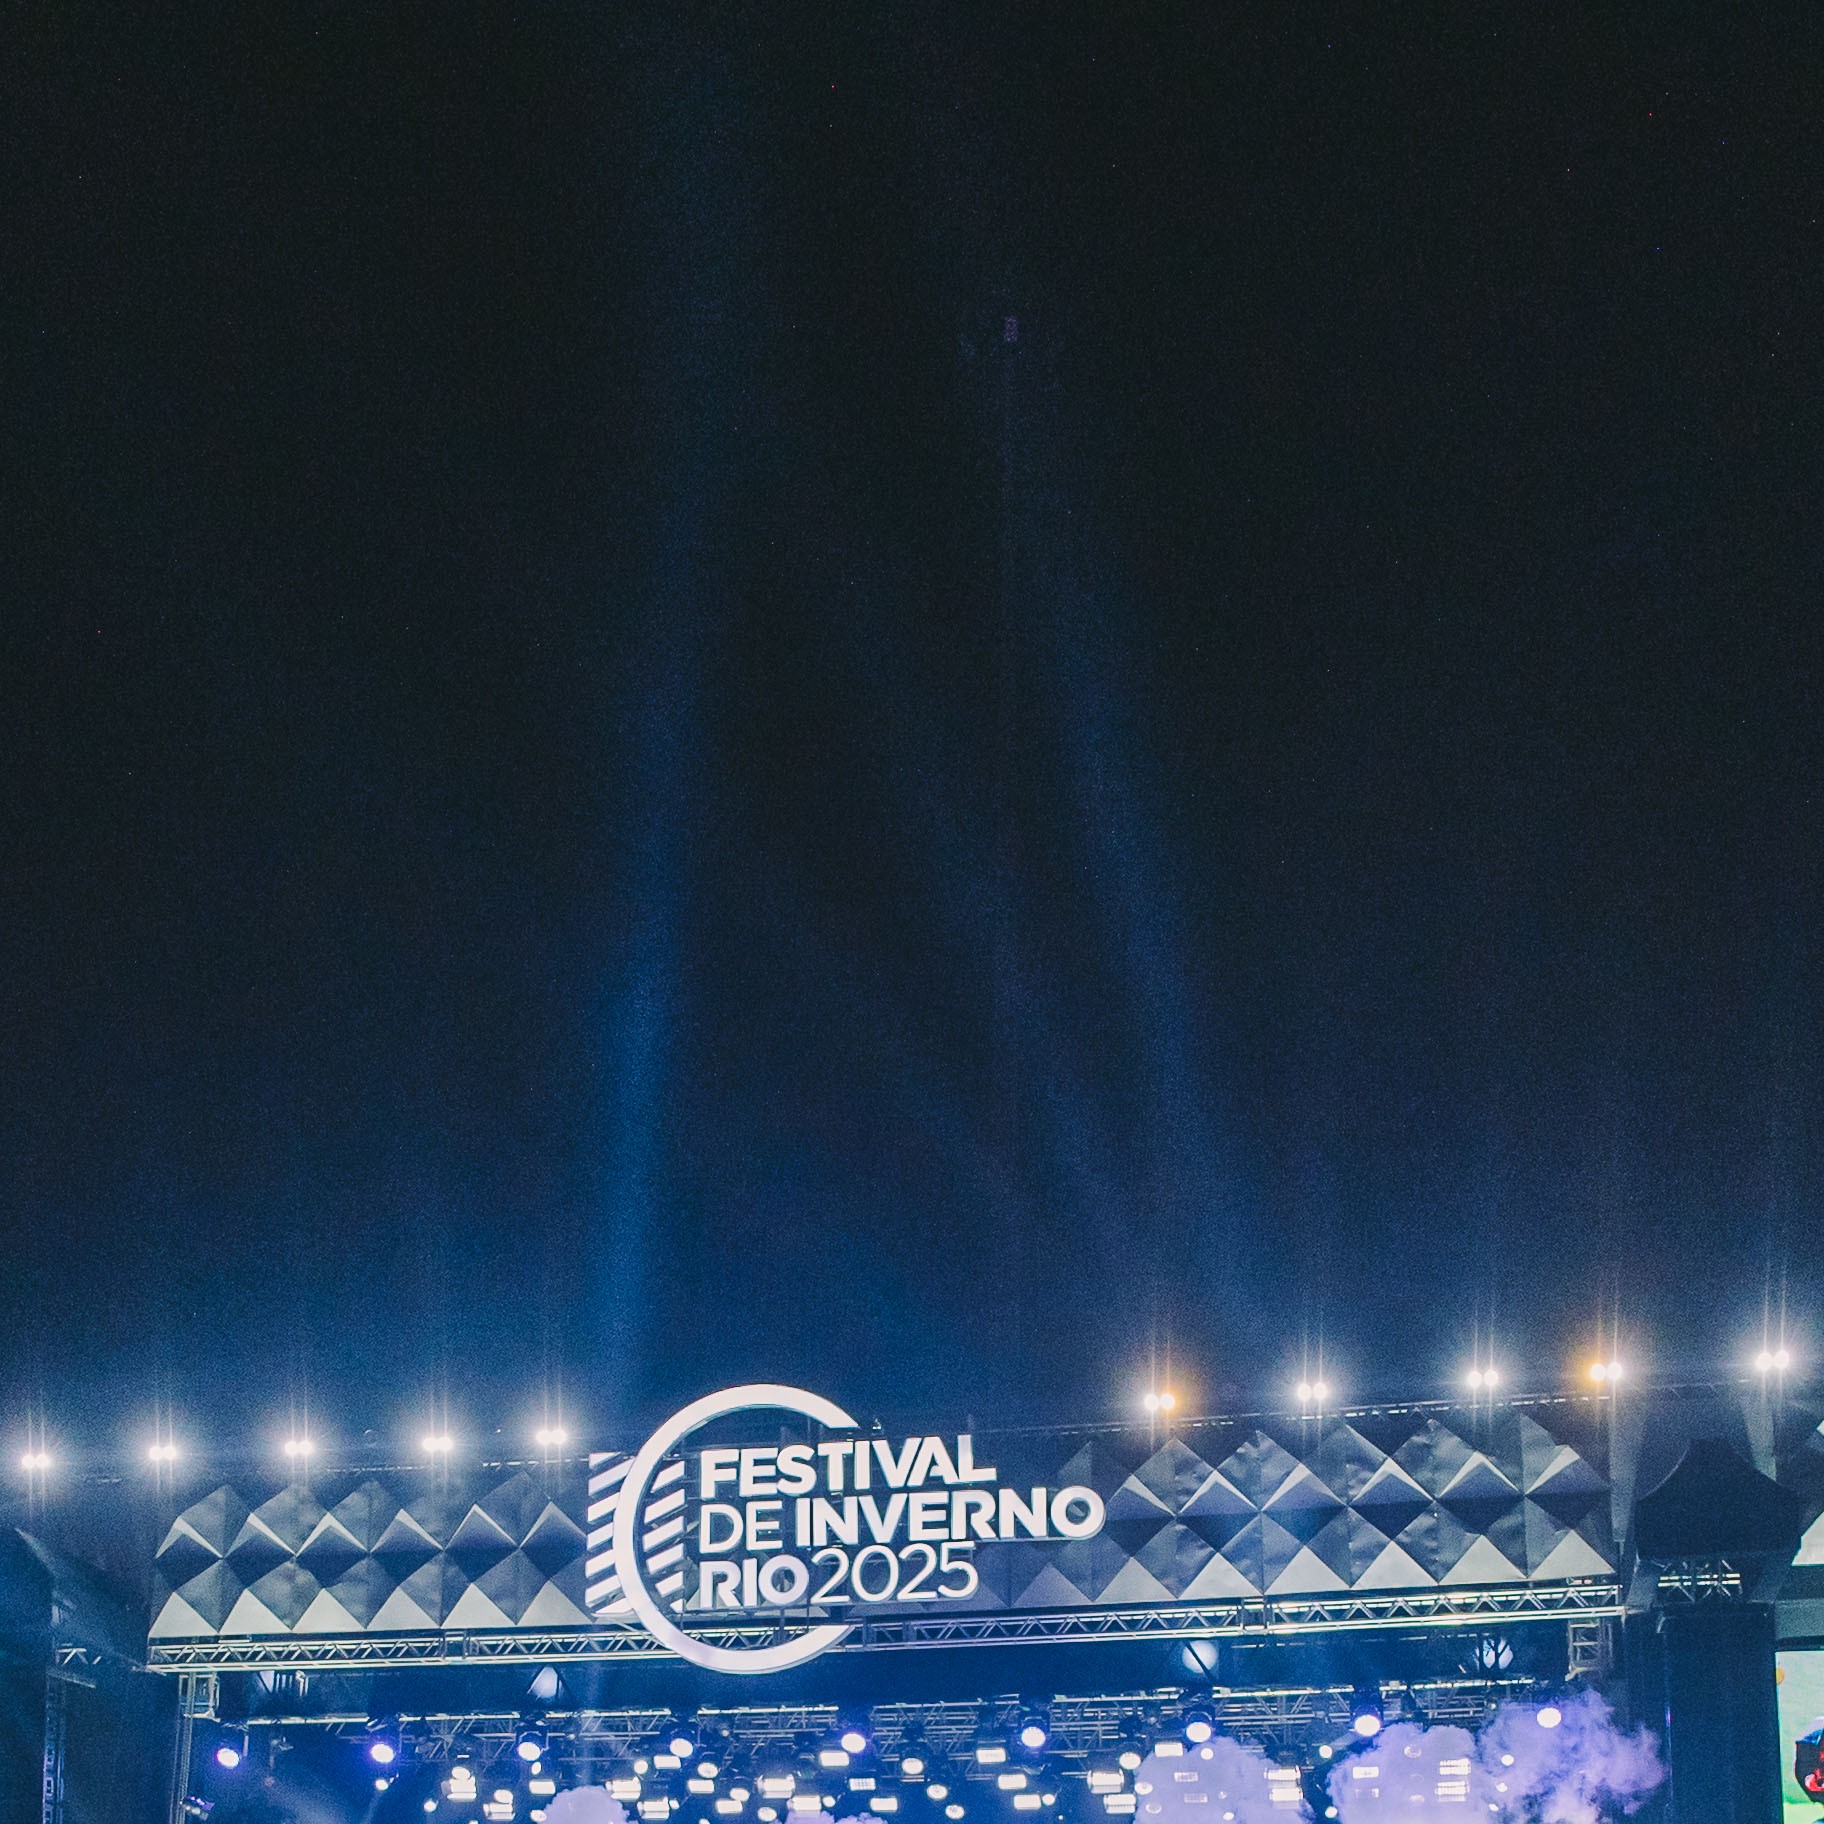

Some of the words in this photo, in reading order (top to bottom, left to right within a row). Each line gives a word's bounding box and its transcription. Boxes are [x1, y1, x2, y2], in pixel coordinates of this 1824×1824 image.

[700, 1434, 997, 1499] FESTIVAL
[699, 1500, 783, 1554] DE
[795, 1486, 1107, 1547] INVERNO
